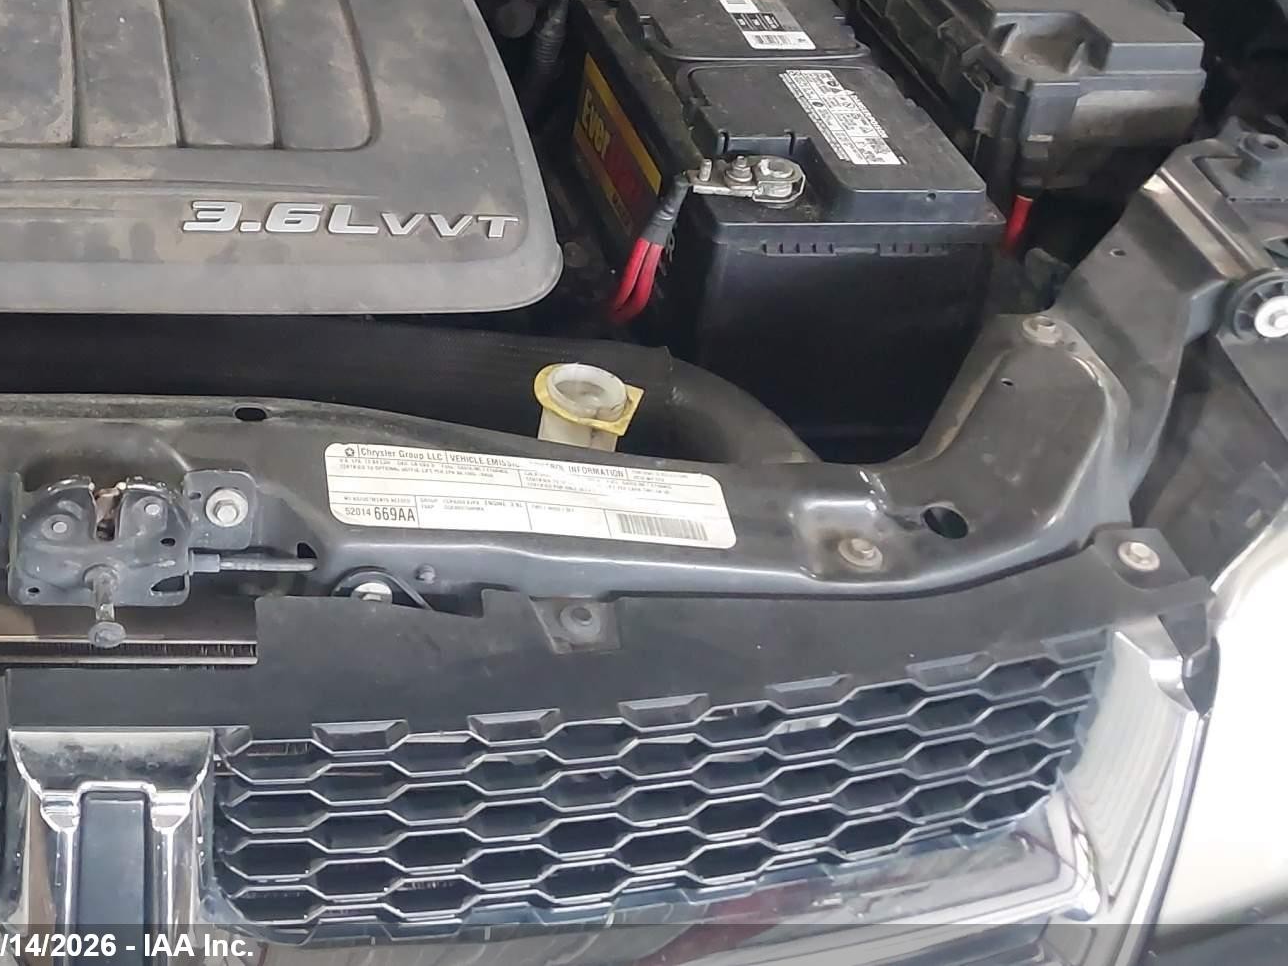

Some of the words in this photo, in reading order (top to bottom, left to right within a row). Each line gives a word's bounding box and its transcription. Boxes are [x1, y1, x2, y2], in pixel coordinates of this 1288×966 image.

[183, 200, 379, 234] 3.6L
[381, 212, 519, 238] VVT
[360, 447, 396, 457] Chrysler
[398, 449, 424, 460] Group
[426, 452, 443, 461] LLC
[449, 454, 484, 464] VEHICLE
[568, 465, 624, 477] INFORMATION
[374, 506, 415, 522] 669AA
